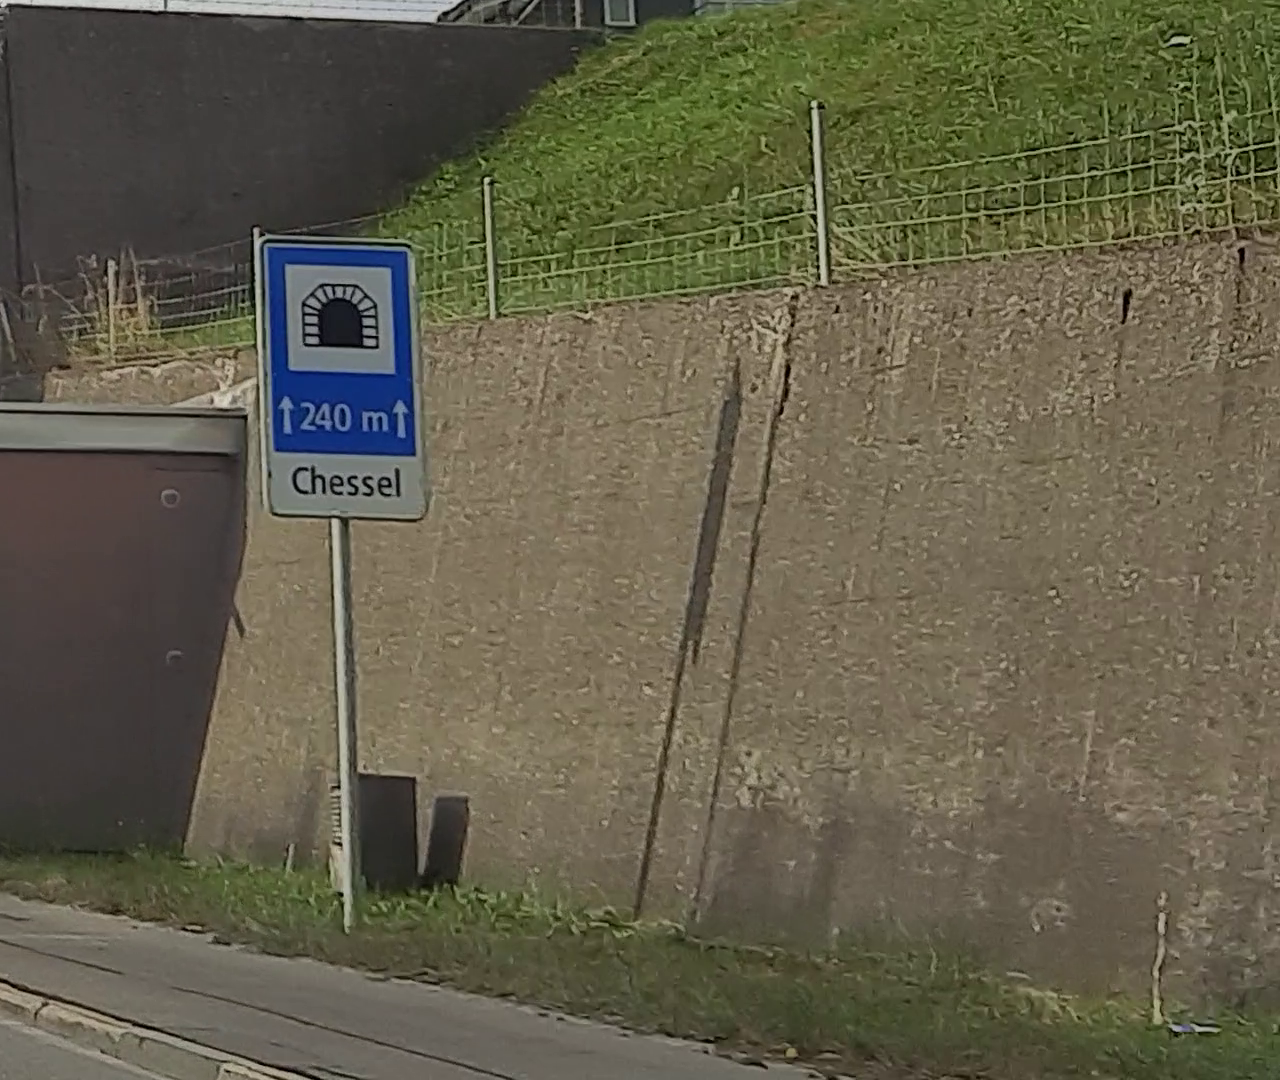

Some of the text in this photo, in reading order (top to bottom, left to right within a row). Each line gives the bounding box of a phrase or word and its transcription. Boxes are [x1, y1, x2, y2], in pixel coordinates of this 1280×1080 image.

[300, 401, 389, 432] 240 m
[291, 465, 401, 497] Chessel
